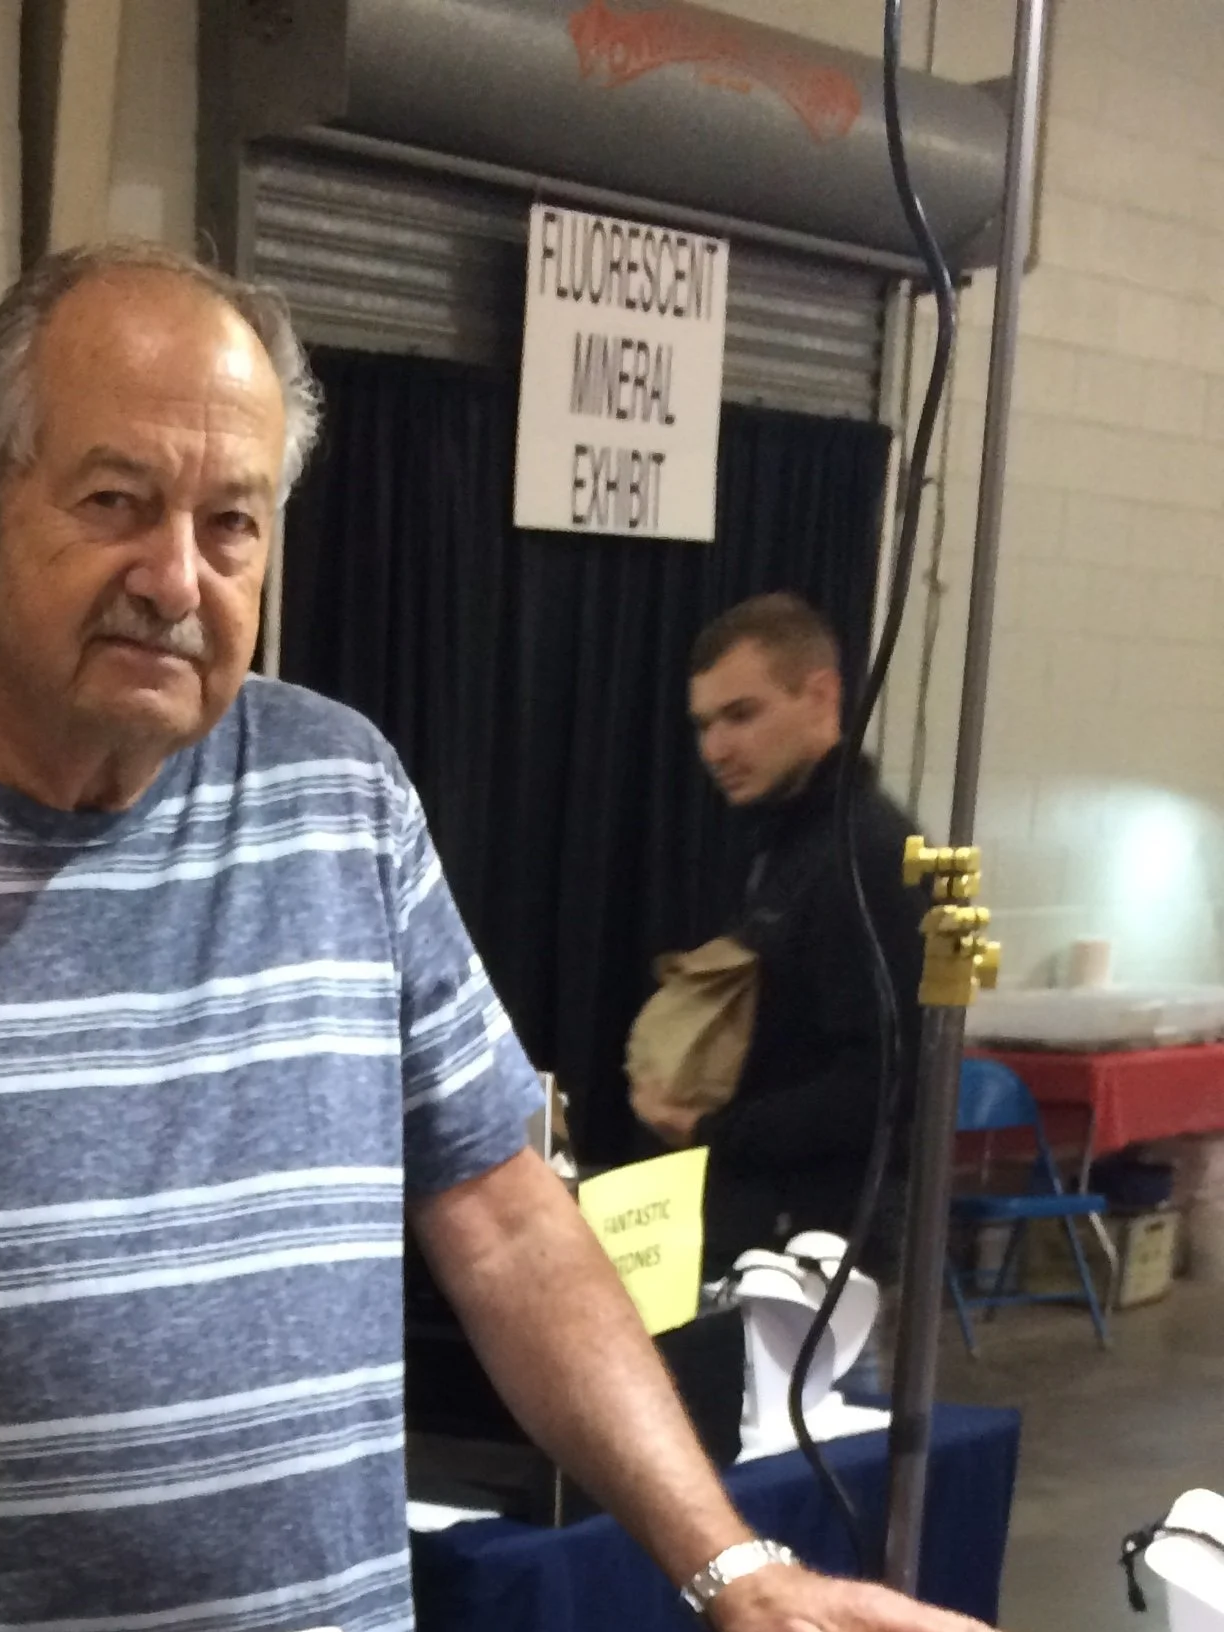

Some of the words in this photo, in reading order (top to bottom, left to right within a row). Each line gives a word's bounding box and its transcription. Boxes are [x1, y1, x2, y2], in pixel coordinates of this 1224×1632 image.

[540, 210, 718, 322] FLUORESCENT
[570, 332, 676, 425] MINERAL
[572, 443, 665, 531] EXHIBIT
[603, 1198, 671, 1235] FANTASTIC
[613, 1243, 661, 1276] TONES
